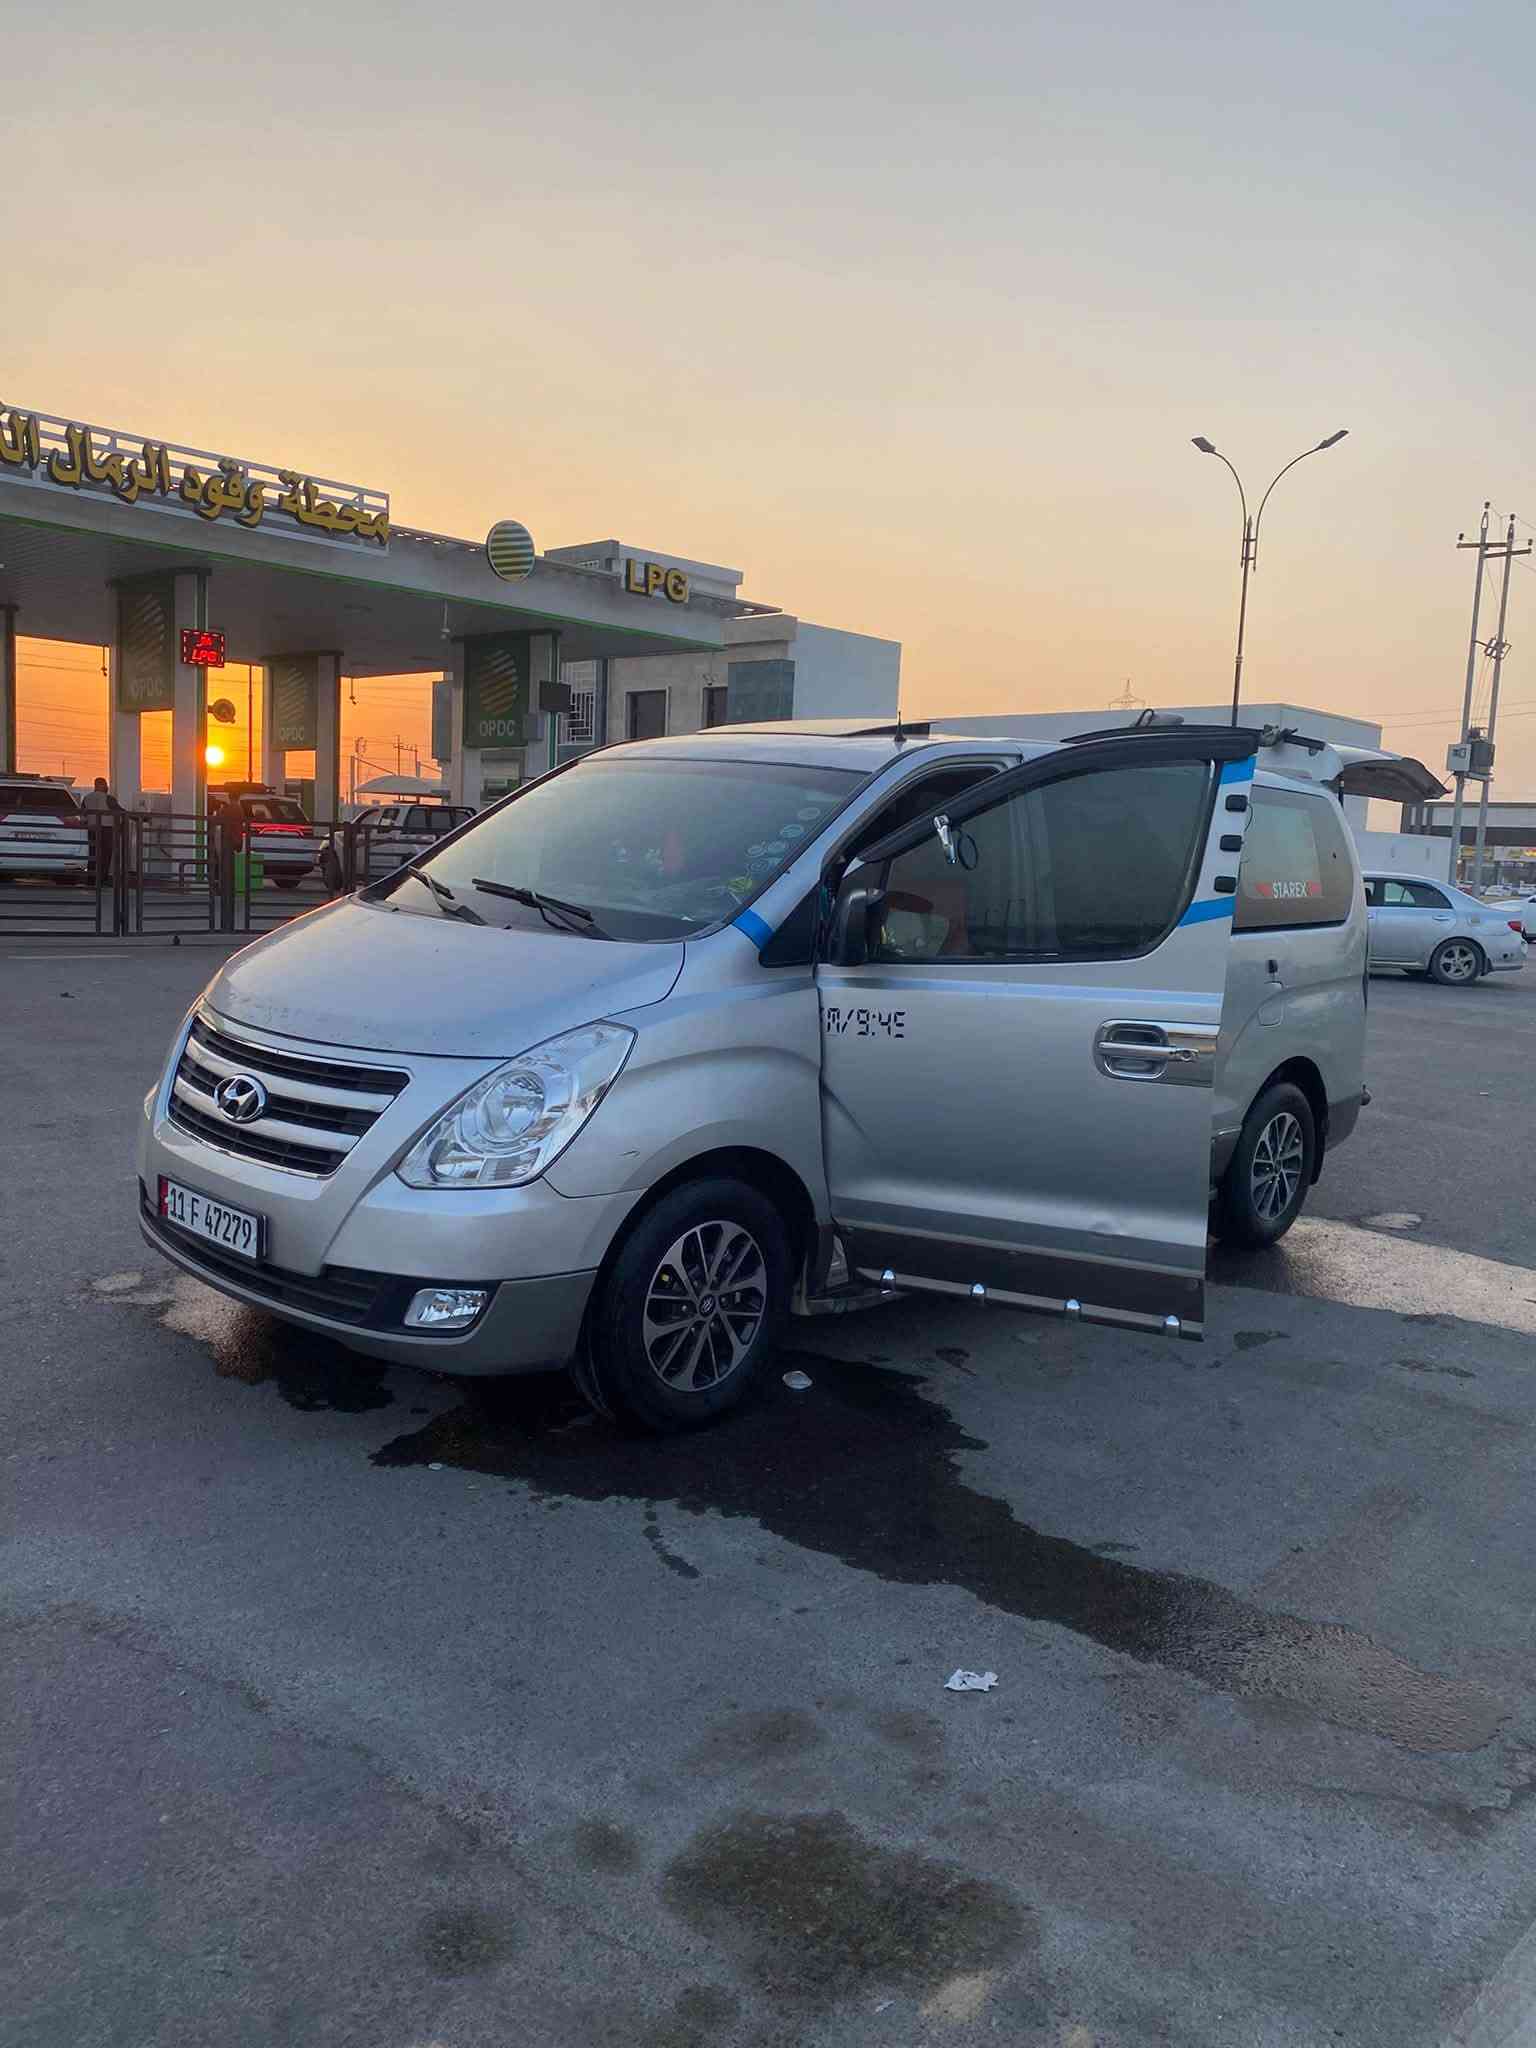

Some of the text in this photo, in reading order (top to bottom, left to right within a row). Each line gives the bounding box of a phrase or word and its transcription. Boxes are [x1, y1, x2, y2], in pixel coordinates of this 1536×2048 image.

[47, 423, 172, 503] الرمال
[179, 457, 265, 527] وقود
[278, 469, 390, 546] محطة
[625, 559, 688, 604] LPG
[479, 719, 515, 737] OPDC
[1272, 881, 1308, 898] STAREX
[169, 1187, 251, 1249] 11 F 47279
